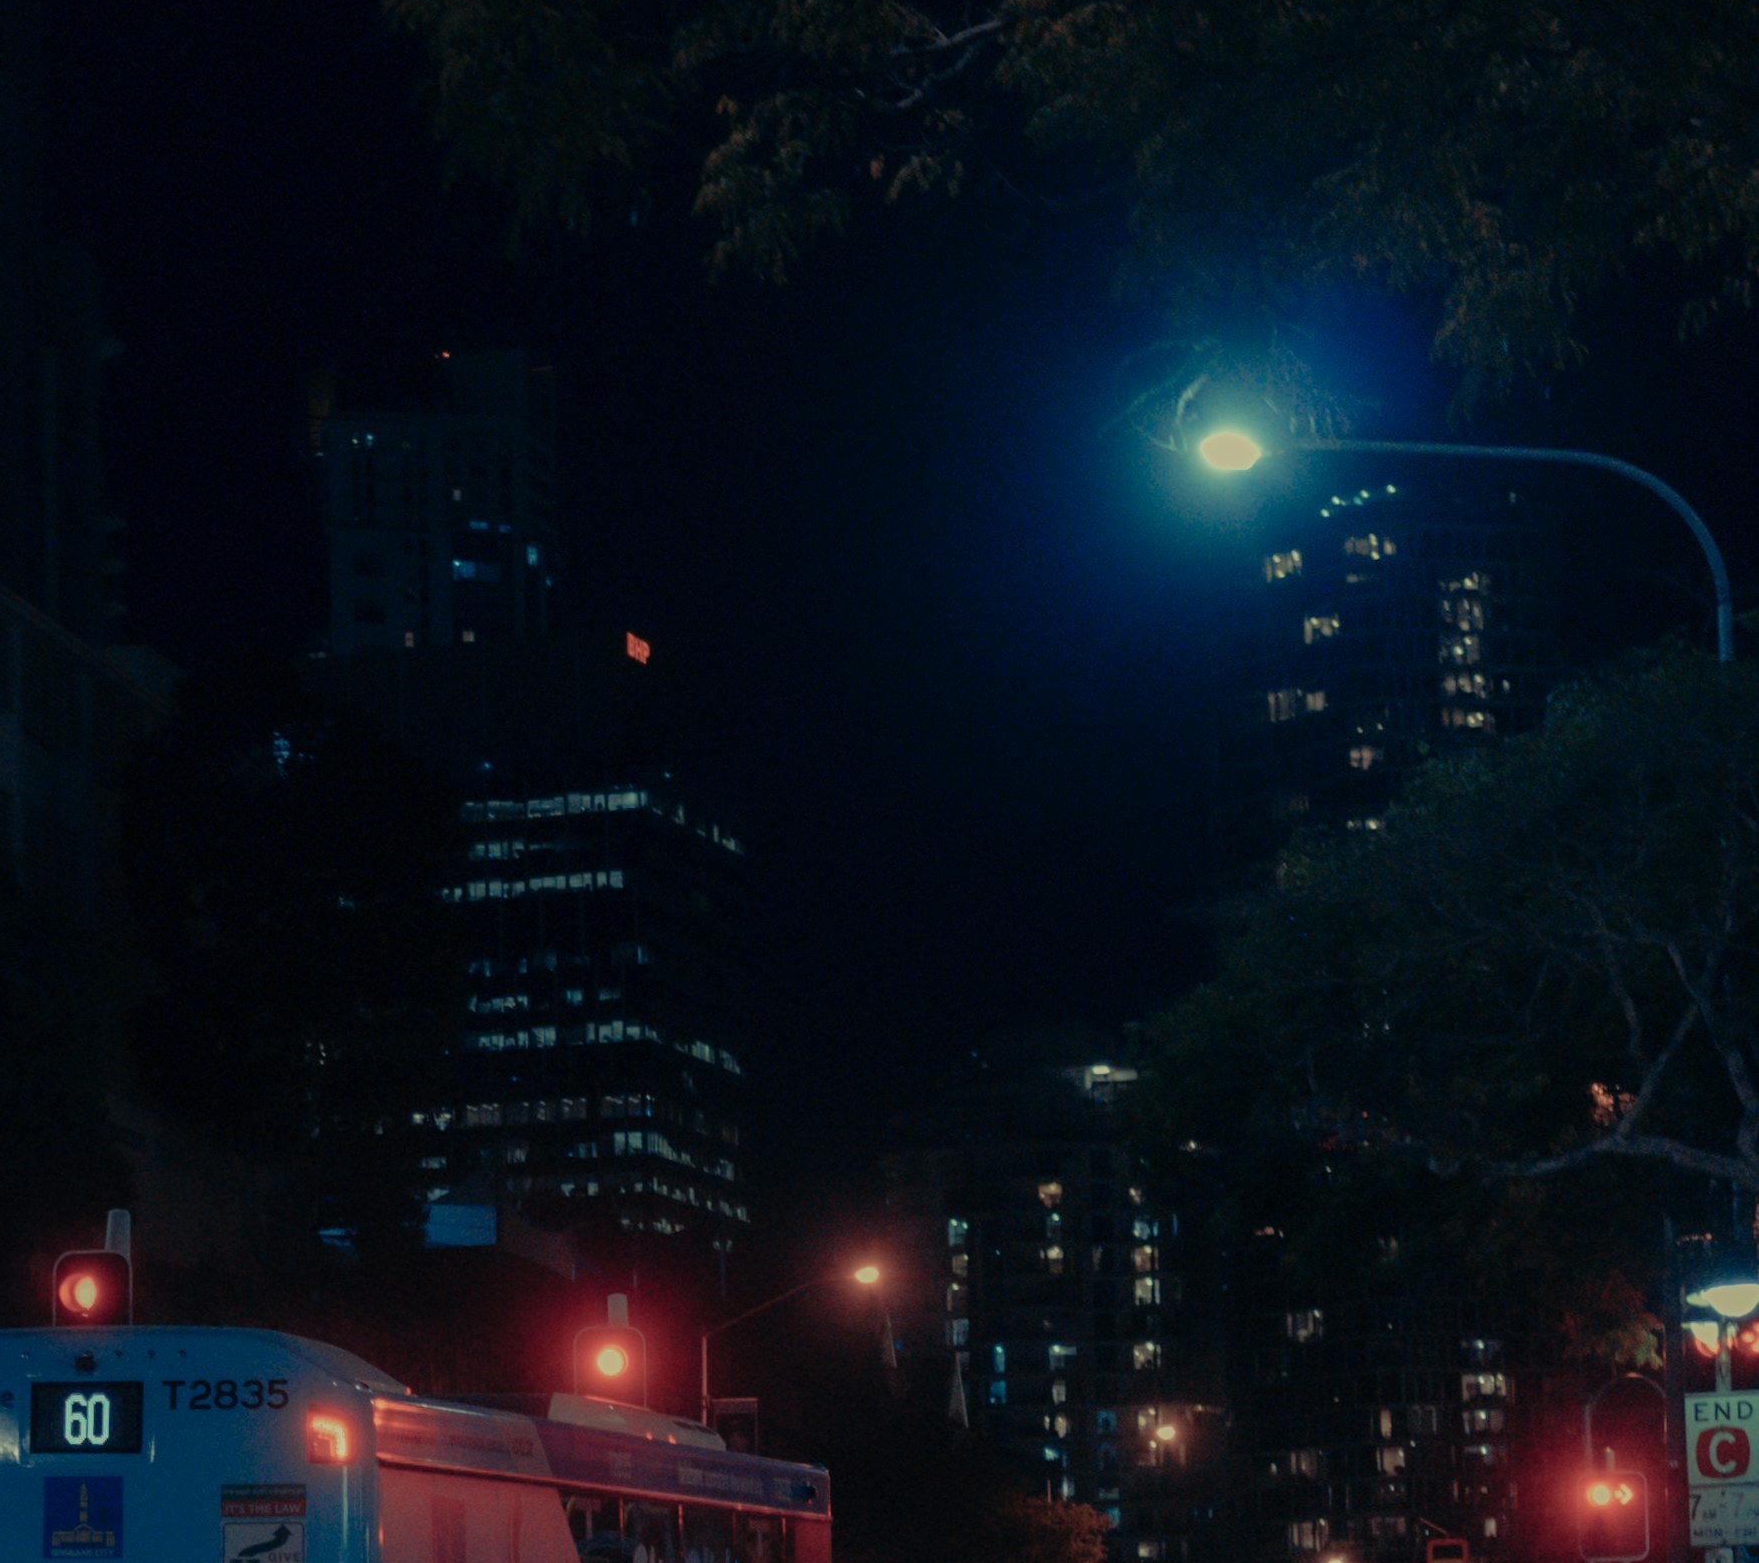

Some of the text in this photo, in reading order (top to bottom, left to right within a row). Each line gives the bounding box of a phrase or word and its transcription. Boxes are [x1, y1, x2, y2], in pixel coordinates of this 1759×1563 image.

[163, 1379, 289, 1410] T2835
[65, 1393, 110, 1445] 60
[1694, 1401, 1753, 1421] END
[1709, 1431, 1738, 1474] C
[248, 1502, 272, 1514] THE
[275, 1502, 302, 1514] LAW
[1690, 1493, 1702, 1520] 7
[268, 1552, 301, 1562] GIVE
